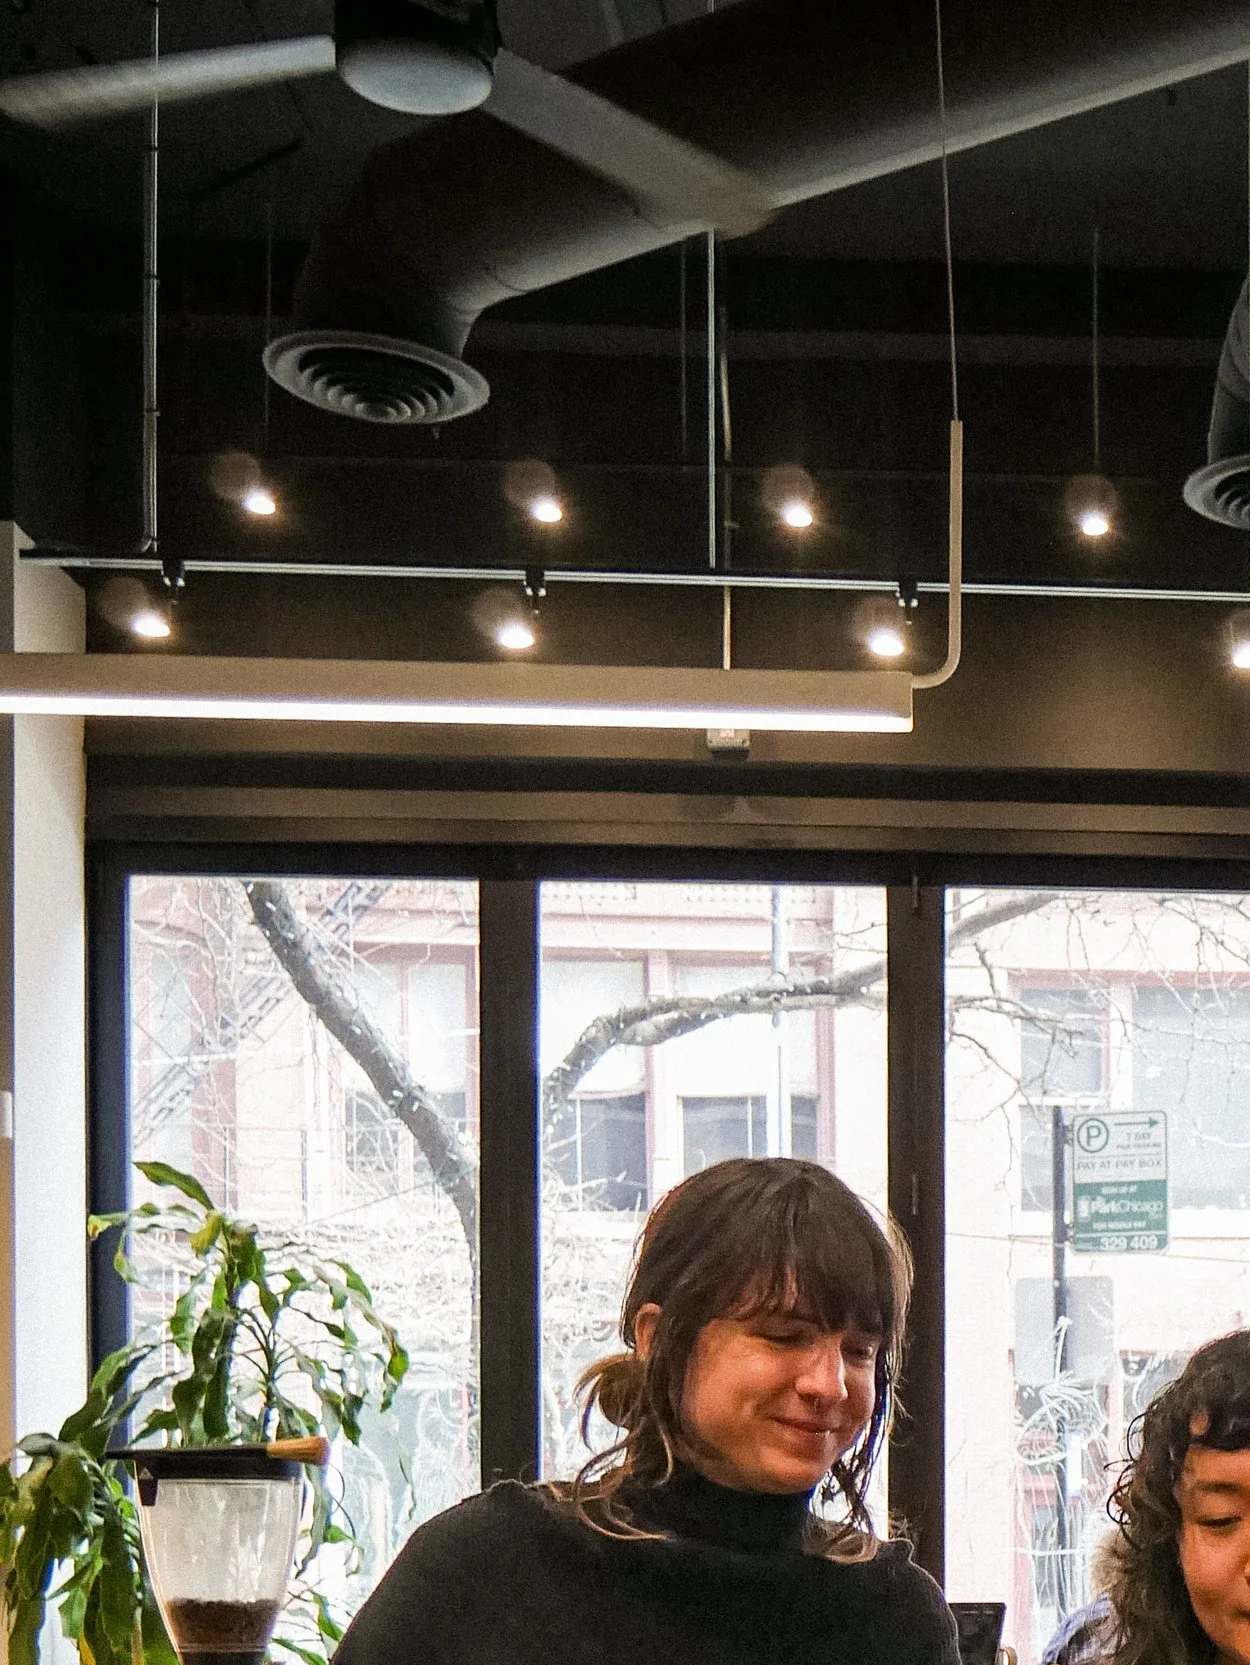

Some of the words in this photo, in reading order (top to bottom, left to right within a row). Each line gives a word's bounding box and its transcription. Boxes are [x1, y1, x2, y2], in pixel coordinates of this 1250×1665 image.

[1086, 1125, 1101, 1147] P
[1077, 1161, 1096, 1171] PAY
[1099, 1160, 1112, 1170] AT
[1115, 1159, 1137, 1169] PAY
[1138, 1157, 1162, 1169] BOX
[1091, 1196, 1164, 1215] ParkChicago
